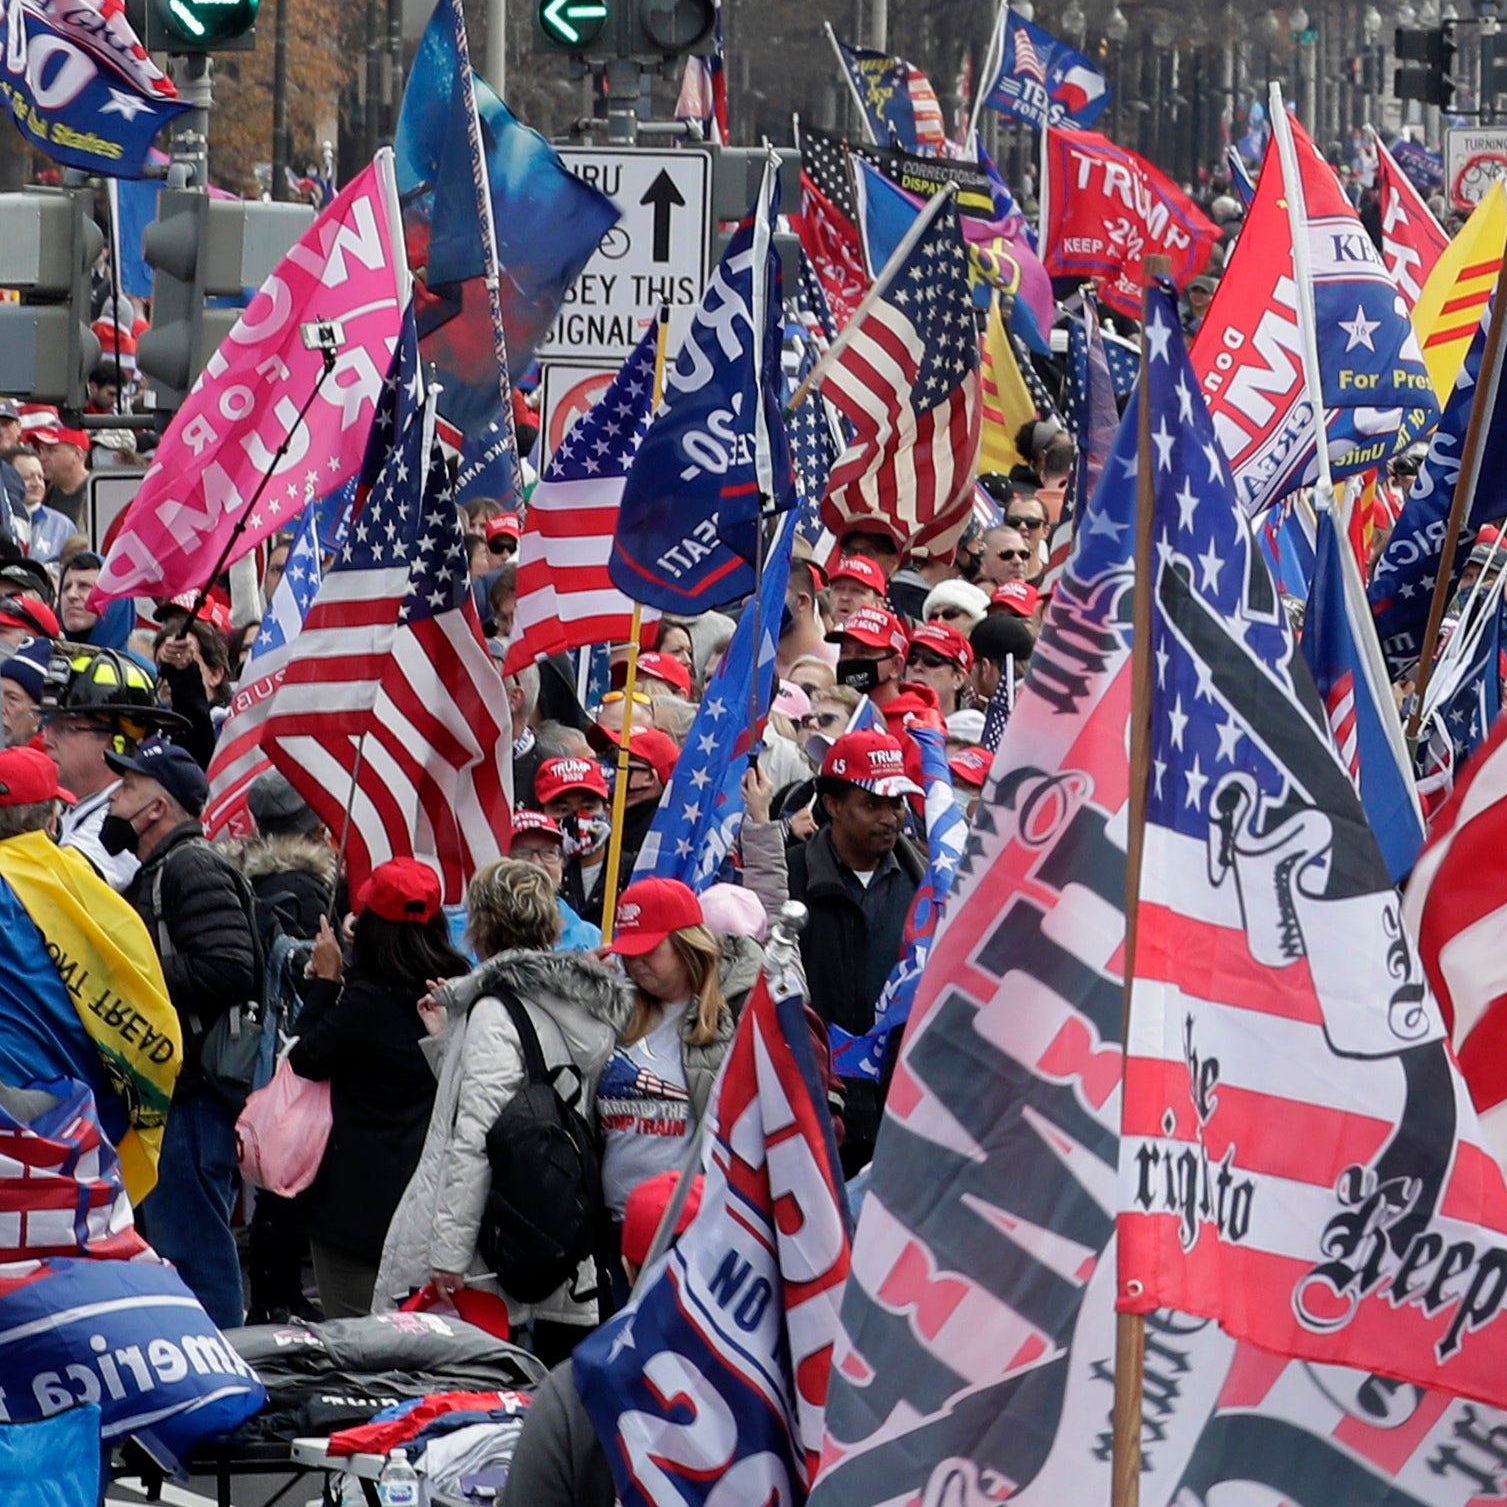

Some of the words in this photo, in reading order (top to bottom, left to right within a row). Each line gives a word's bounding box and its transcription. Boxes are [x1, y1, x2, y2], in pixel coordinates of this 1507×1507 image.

[576, 164, 622, 196] RU
[901, 175, 944, 194] DISPA
[1070, 149, 1190, 251] TRUMP
[1063, 236, 1104, 254] KEEP
[630, 275, 695, 306] THIS
[1113, 272, 1143, 298] REA
[1350, 323, 1369, 337] '16
[1338, 368, 1380, 391] For
[831, 757, 847, 776] 45
[866, 749, 904, 767] TRUMP
[550, 759, 592, 778] TRUMP
[562, 771, 585, 783] 2020
[659, 1101, 689, 1120] THE
[634, 1117, 687, 1137] TRAIN
[708, 1249, 775, 1333] NO
